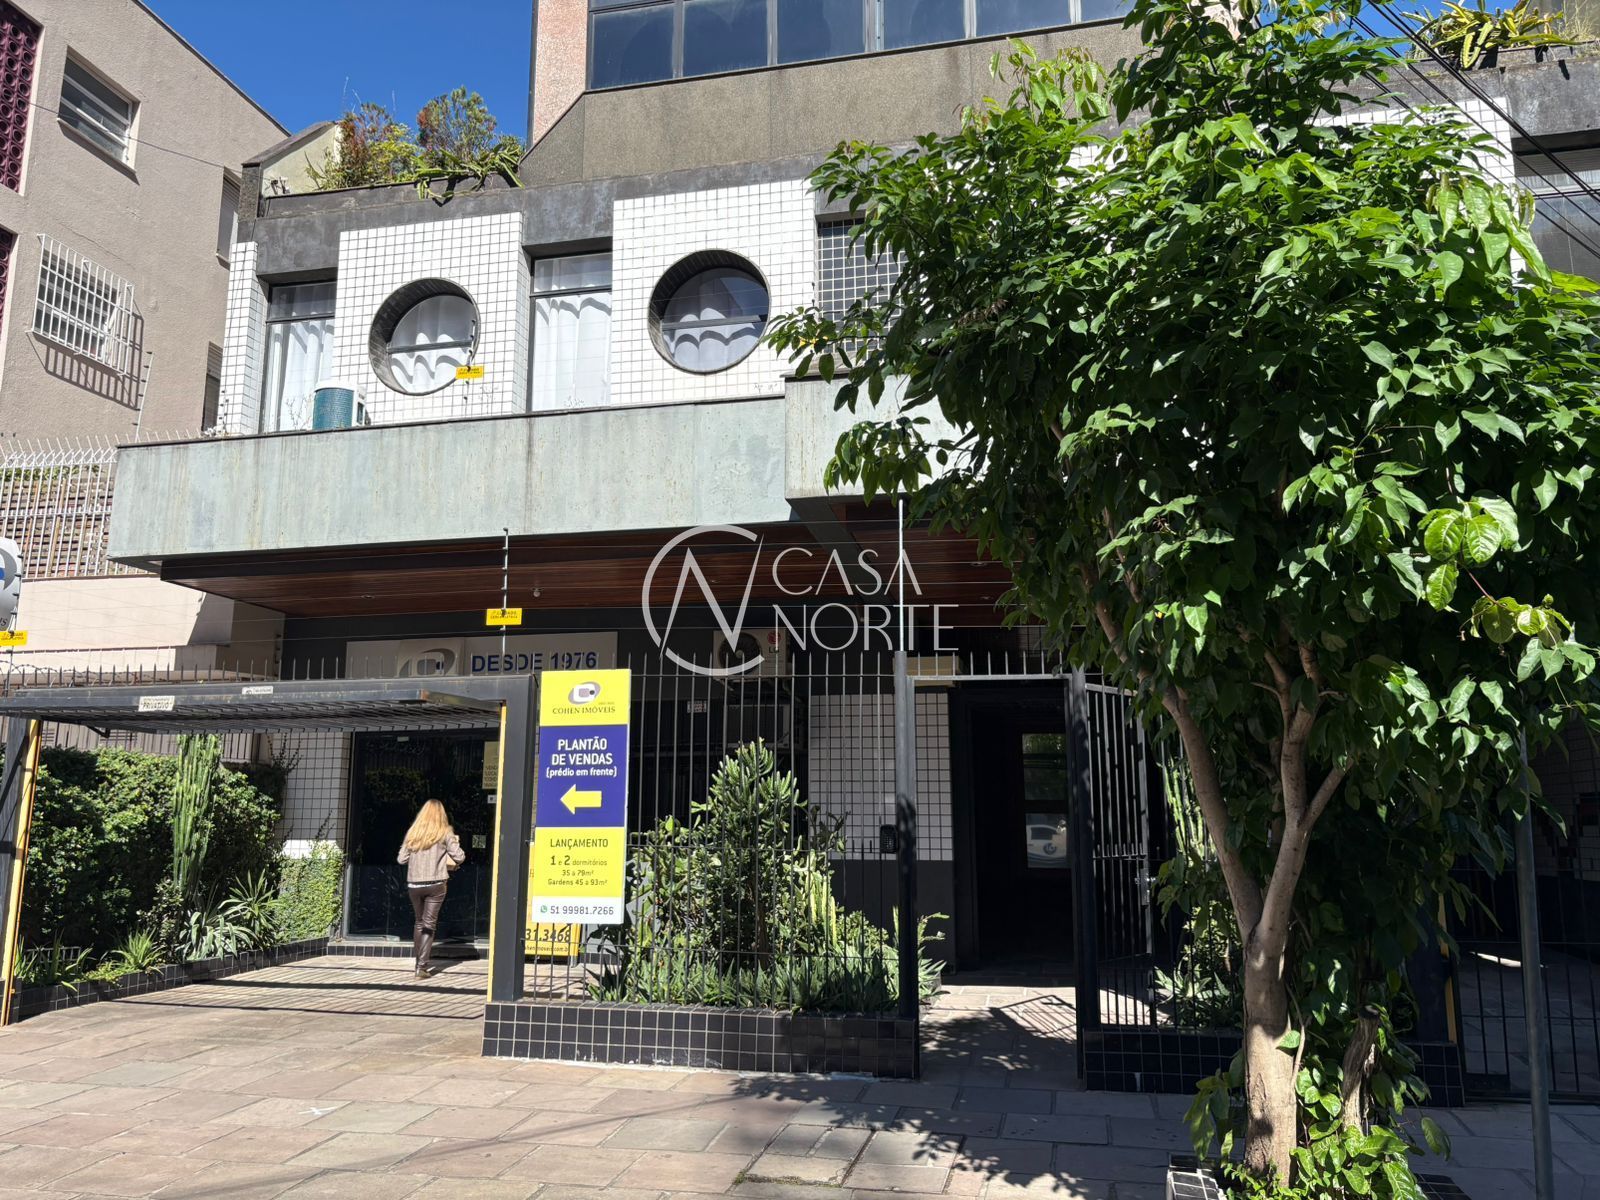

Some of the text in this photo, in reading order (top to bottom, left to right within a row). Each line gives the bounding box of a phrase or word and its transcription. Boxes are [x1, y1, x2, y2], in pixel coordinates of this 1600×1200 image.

[472, 652, 597, 673] DESDE 1976
[581, 705, 616, 714] IMÓVEIS
[557, 736, 607, 751] PLANTÃO
[551, 752, 613, 765] DE VENDAS
[550, 838, 609, 850] LANÇAMENTO
[550, 855, 556, 866] 1
[564, 855, 571, 866] 2
[547, 878, 574, 886] Gardens
[575, 878, 584, 886] 45
[550, 905, 614, 915] 51 99981.7266
